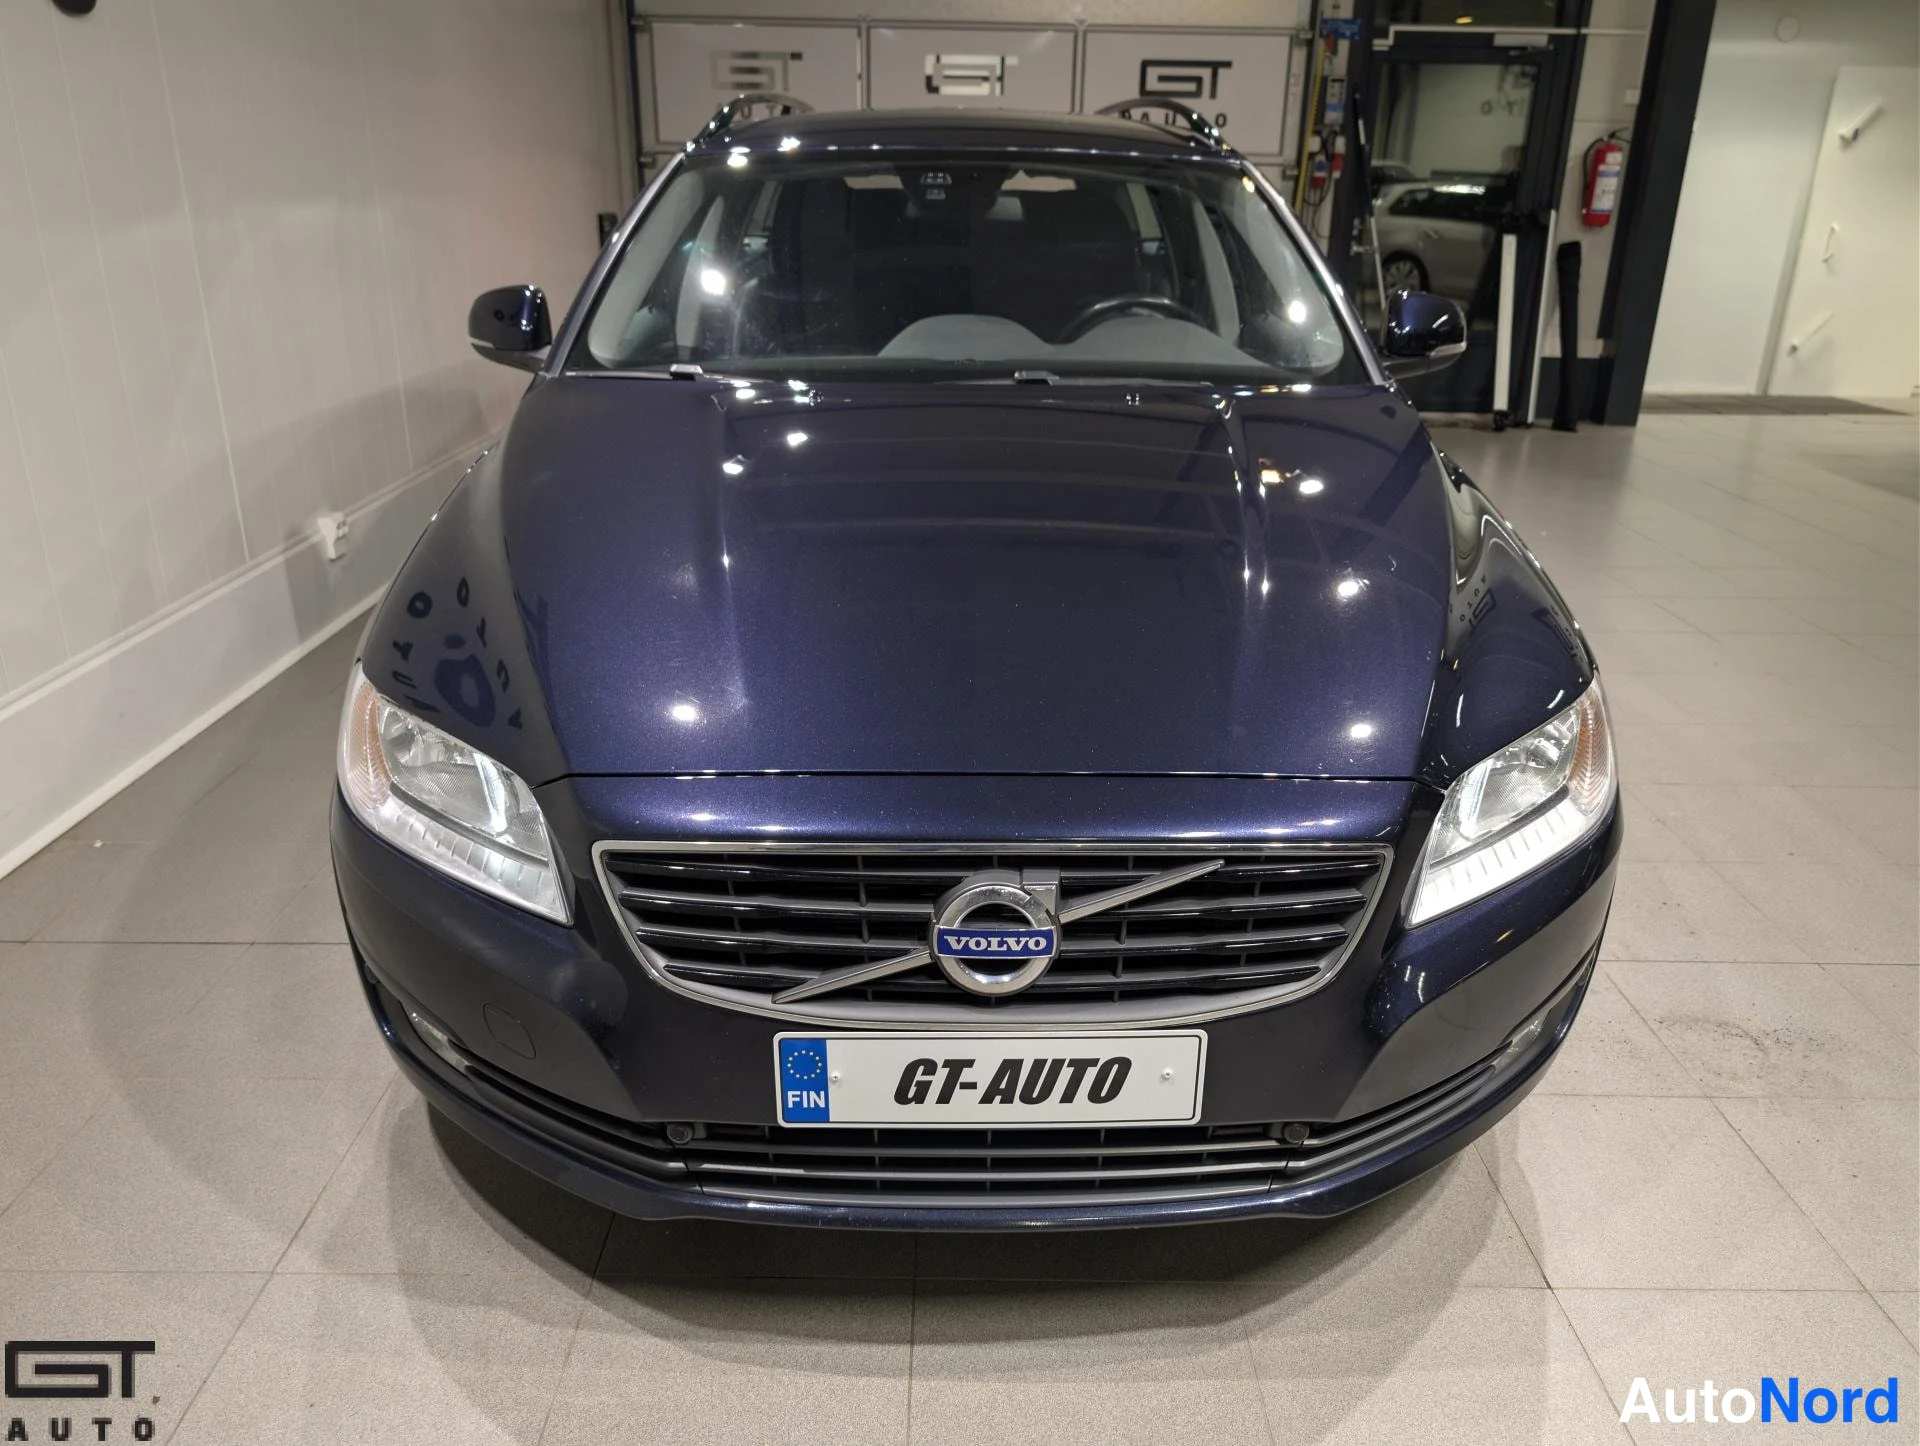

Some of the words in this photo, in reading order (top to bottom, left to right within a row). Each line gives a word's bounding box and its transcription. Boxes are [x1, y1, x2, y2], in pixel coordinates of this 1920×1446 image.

[1140, 60, 1232, 99] GT
[943, 935, 1047, 951] VOLVO
[893, 1056, 1133, 1106] GT-AUTO
[787, 1090, 826, 1109] FIN
